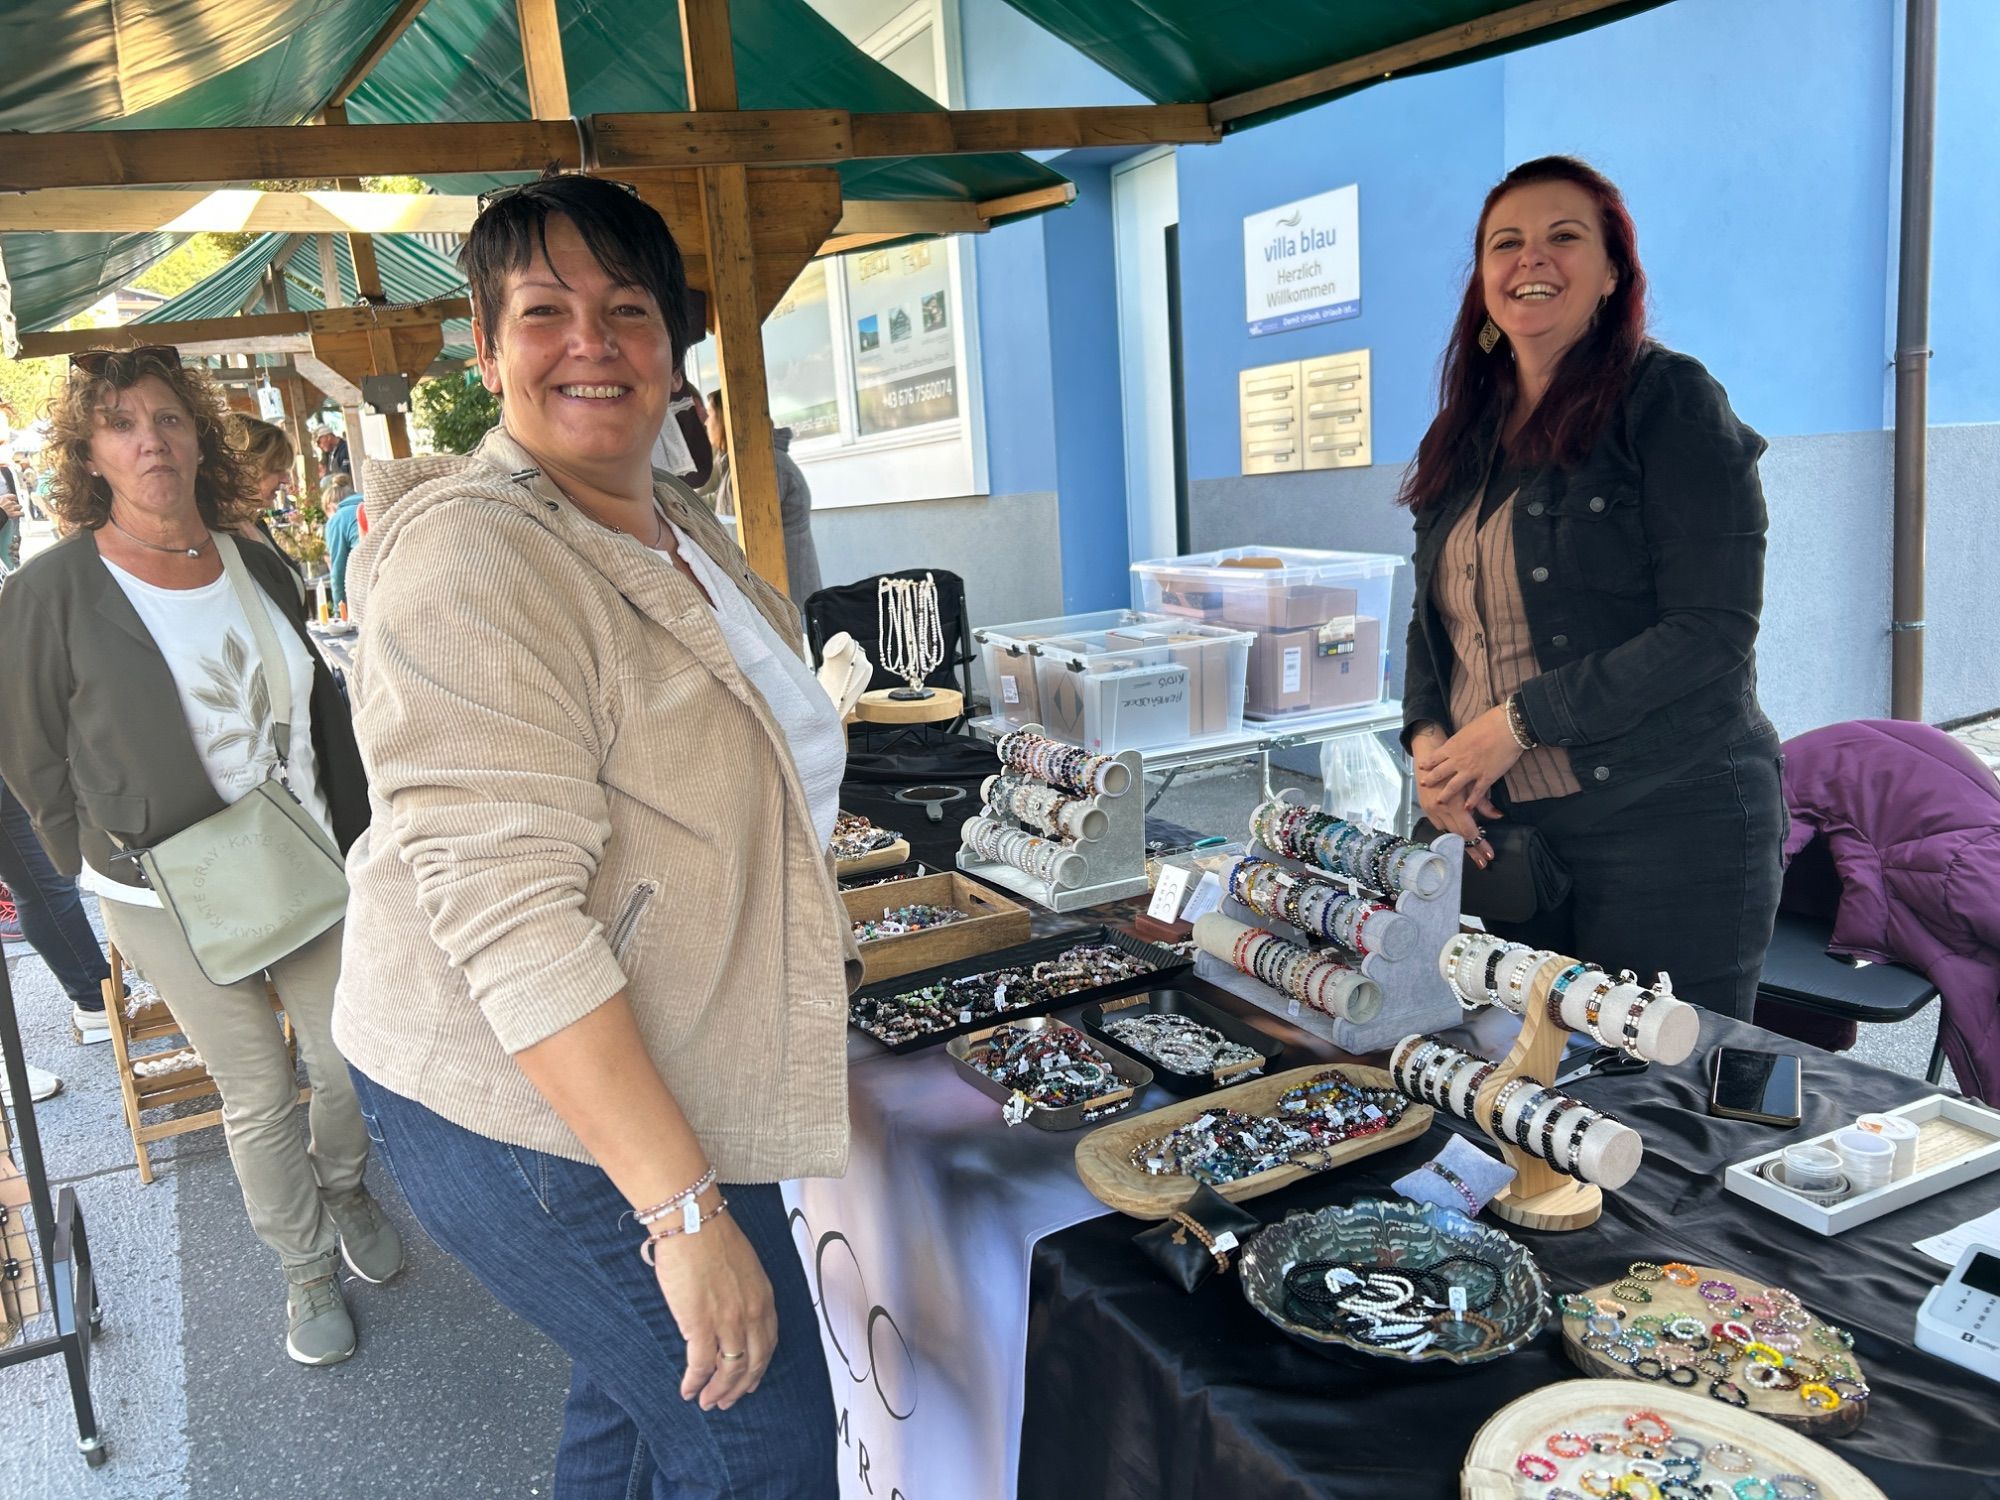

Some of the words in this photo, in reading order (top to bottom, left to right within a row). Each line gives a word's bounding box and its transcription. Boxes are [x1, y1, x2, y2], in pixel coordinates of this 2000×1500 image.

[1264, 235, 1296, 263] villa
[1300, 228, 1336, 254] blau
[1277, 259, 1323, 286] Herzlich
[1266, 281, 1336, 309] Willkommen
[228, 833, 273, 849] KATE
[193, 847, 219, 888] GRAY
[193, 893, 224, 929] KATE
